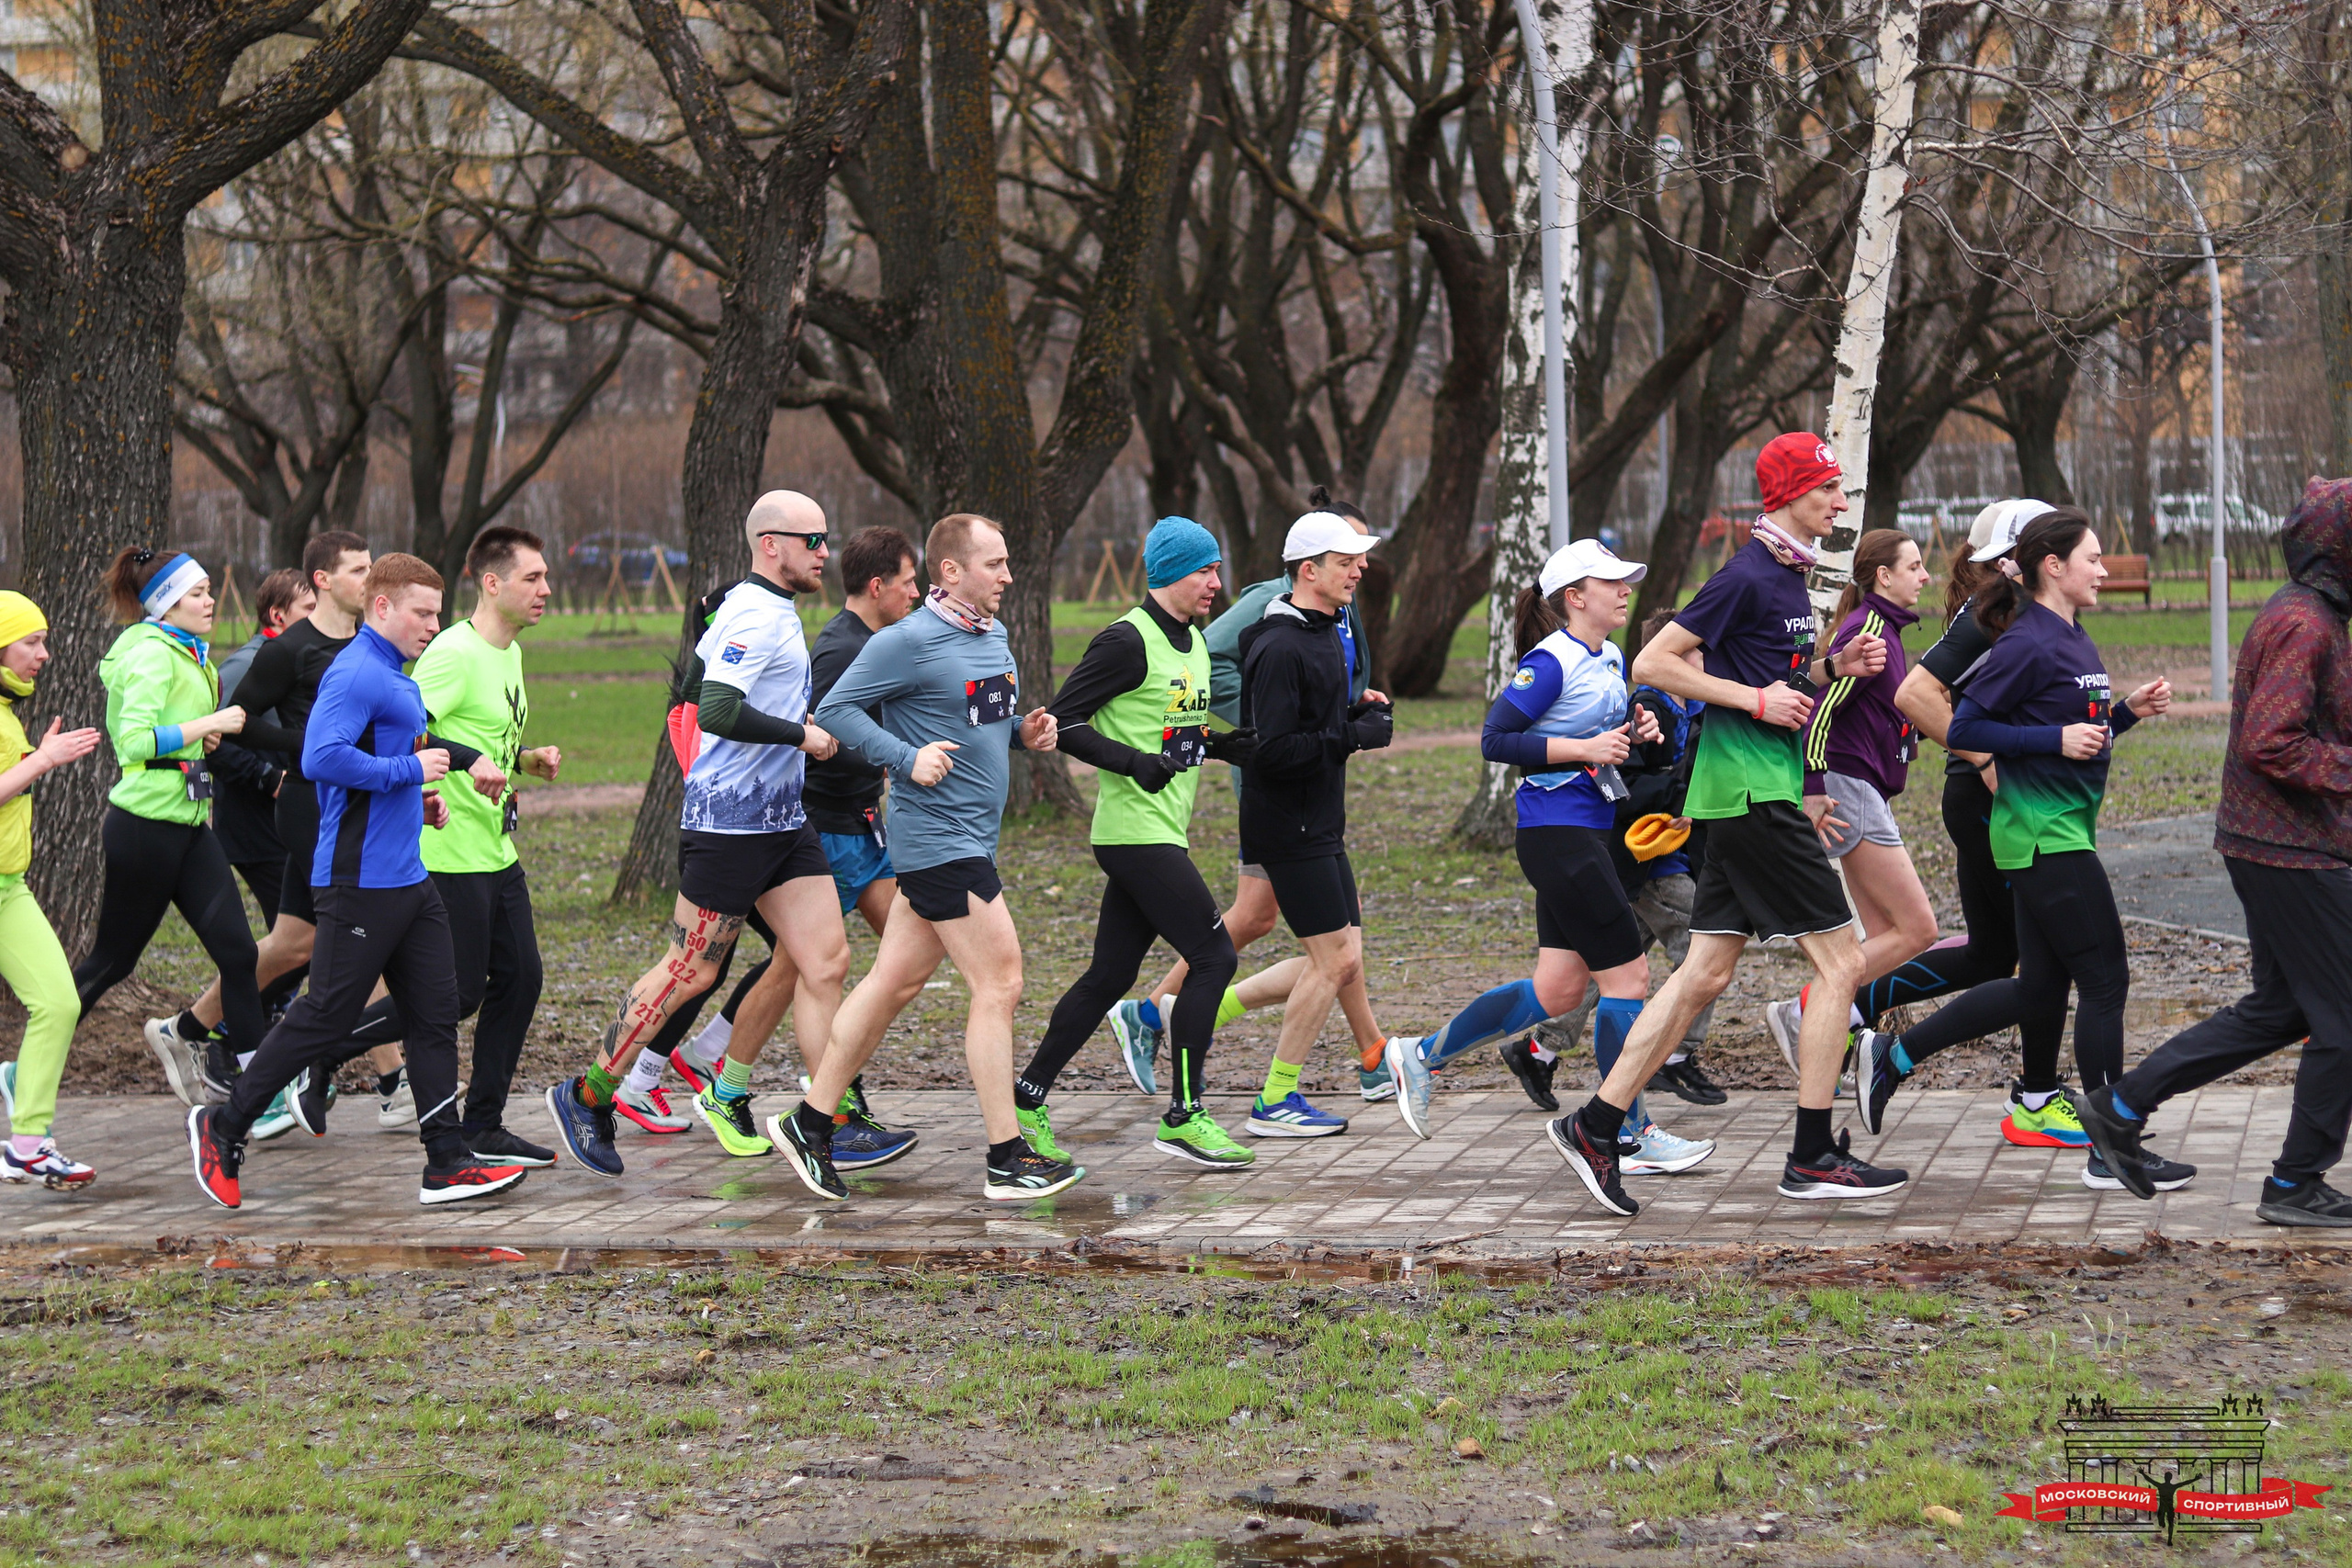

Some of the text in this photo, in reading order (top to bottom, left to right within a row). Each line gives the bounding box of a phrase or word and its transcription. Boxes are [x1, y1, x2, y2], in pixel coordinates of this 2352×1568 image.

[989, 691, 1002, 704] 081
[1163, 715, 1203, 723] Petrushenko
[1182, 740, 1193, 751] 034
[687, 931, 707, 951] 50
